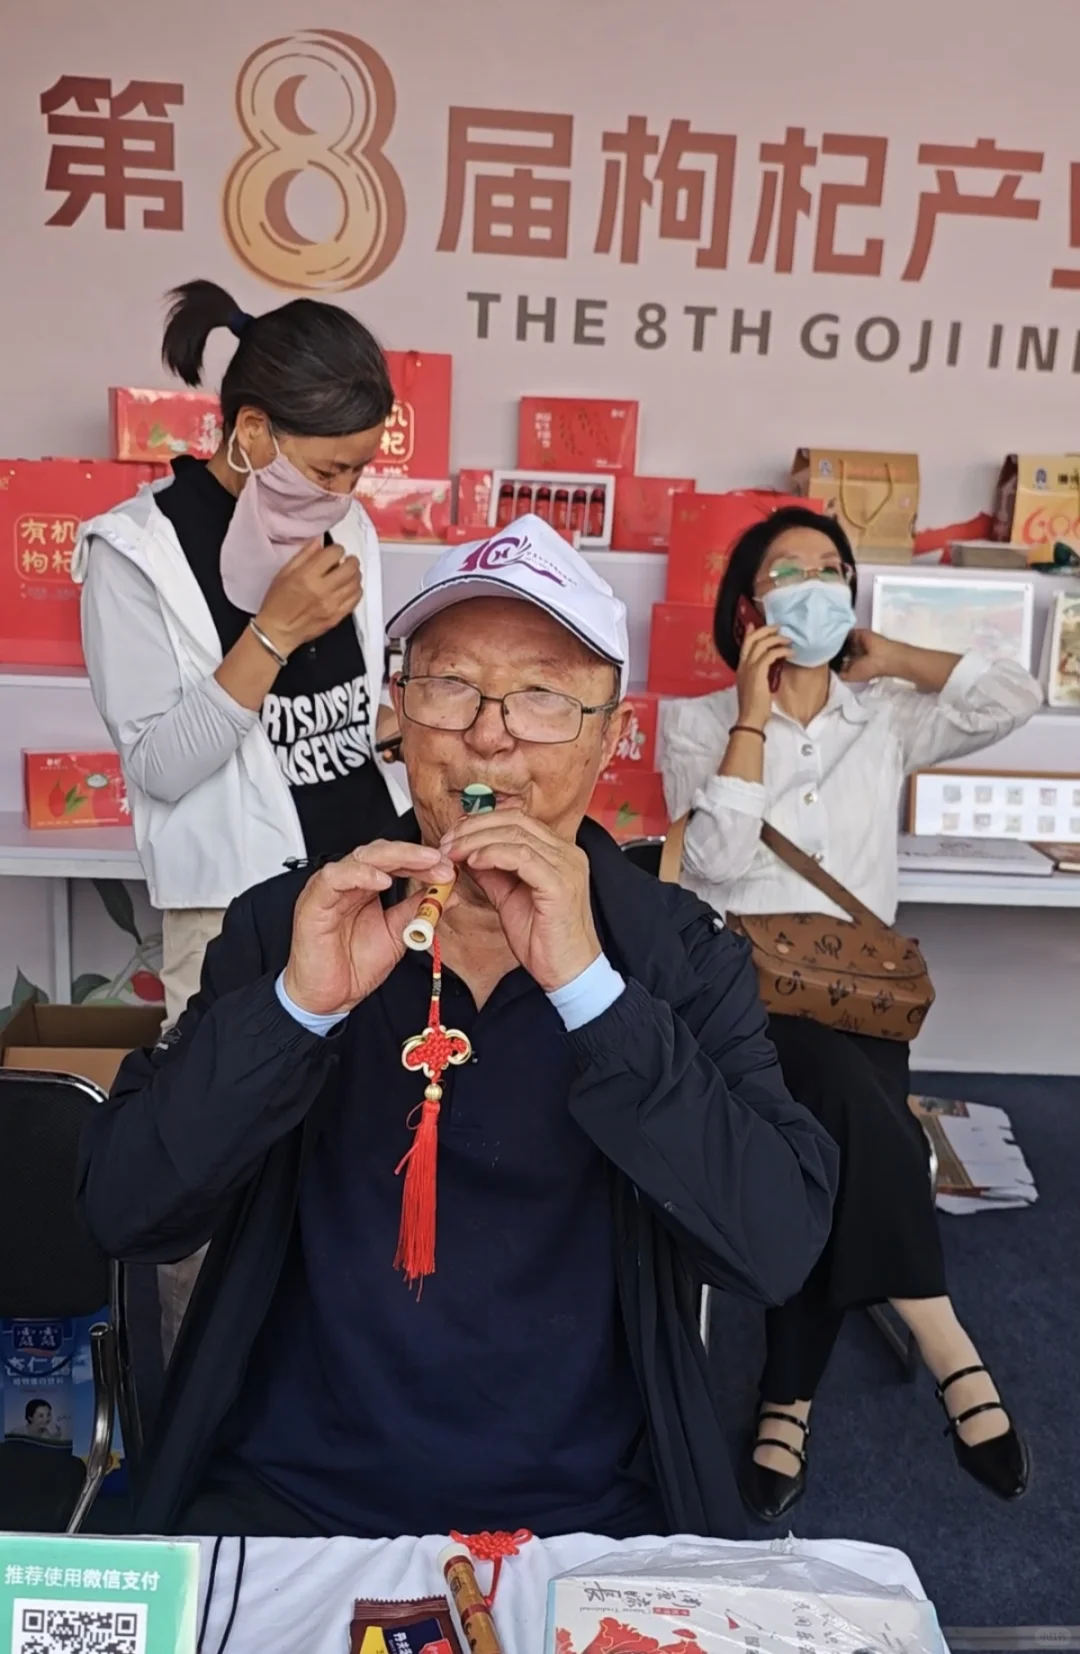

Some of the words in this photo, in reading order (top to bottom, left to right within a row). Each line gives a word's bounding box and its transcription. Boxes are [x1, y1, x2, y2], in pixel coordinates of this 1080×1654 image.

[40, 28, 1080, 292] 第8届枸杞产
[467, 292, 608, 347] THE
[634, 302, 772, 356] 8TH
[800, 313, 962, 373] GOJI
[988, 322, 1080, 373] IN
[21, 518, 77, 545] 有机
[21, 549, 73, 574] 枸杞
[5, 1564, 161, 1592] 推荐使用微信支付
